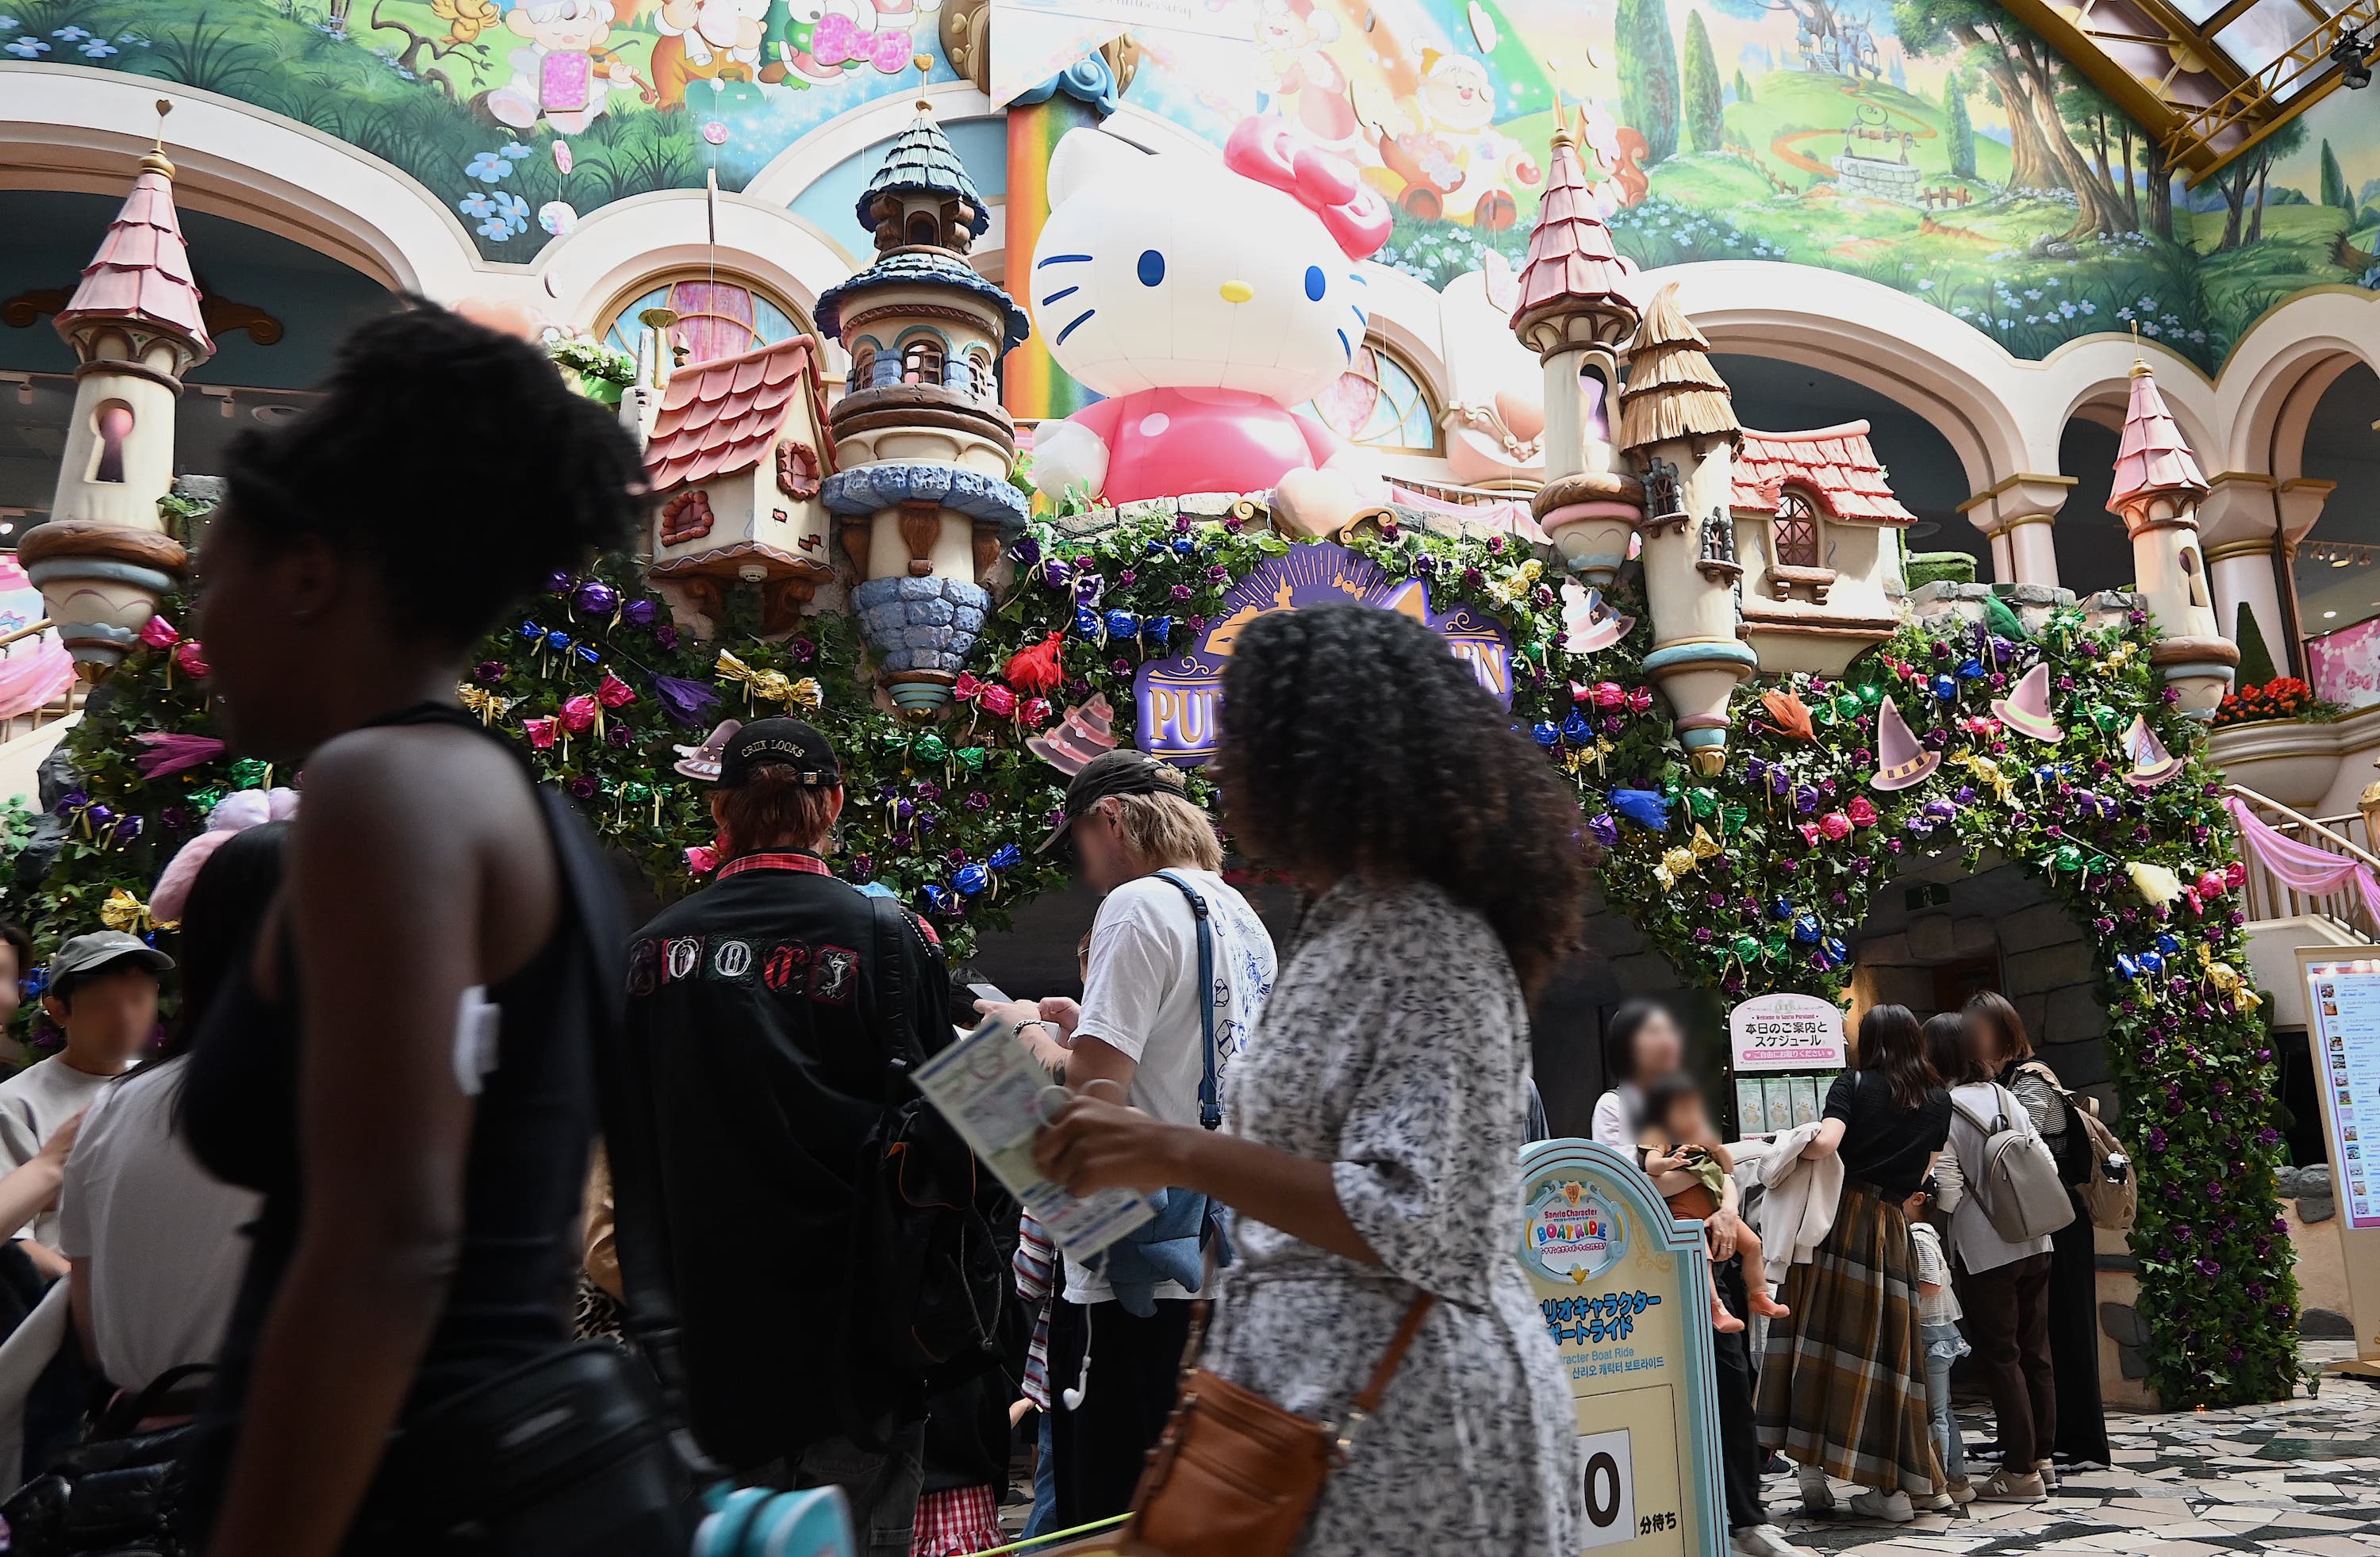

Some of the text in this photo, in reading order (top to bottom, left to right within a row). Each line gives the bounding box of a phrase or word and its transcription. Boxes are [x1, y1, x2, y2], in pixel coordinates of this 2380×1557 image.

[1745, 1021, 1828, 1035] 本日のご案内と
[1755, 1034, 1821, 1048] スケジュール
[1566, 1207, 1598, 1217] Character
[1537, 1220, 1607, 1242] BOAT RIDE
[1539, 1290, 1661, 1324] リオキャラクター
[1591, 1349, 1613, 1362] Boat
[1614, 1346, 1635, 1359] Ride
[1572, 1356, 1664, 1379] 산리오 캐릭터 보트라이드
[1640, 1511, 1677, 1536] 分待ち
